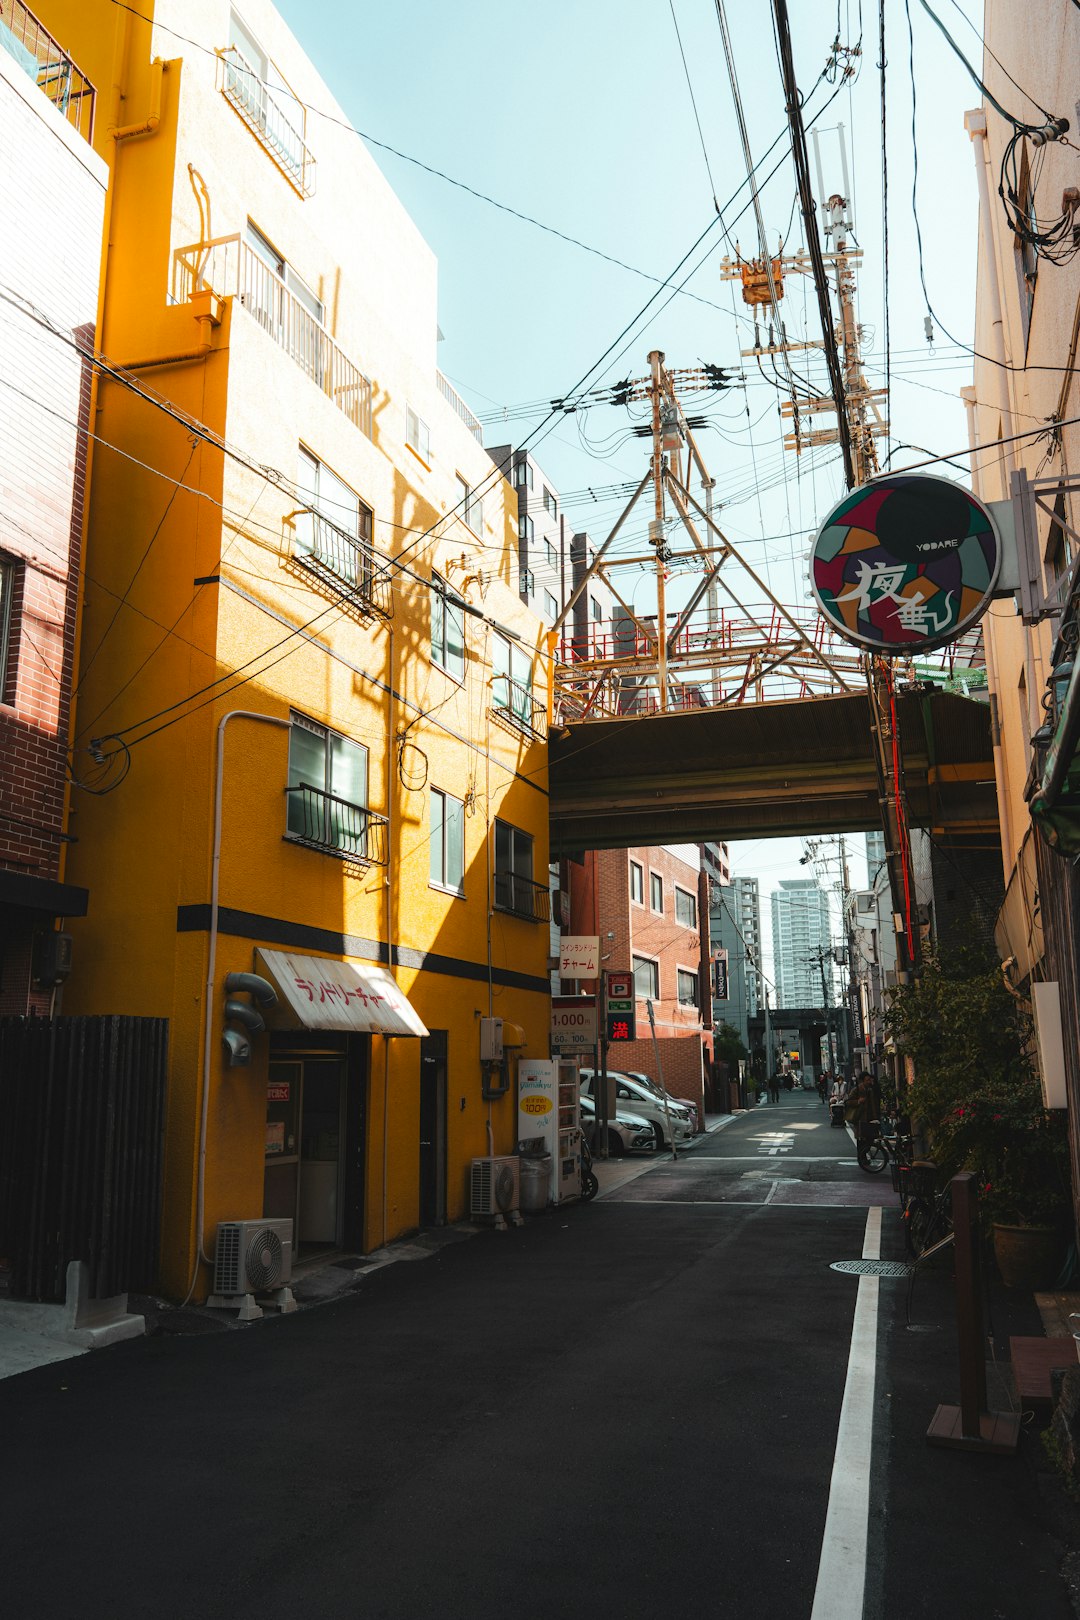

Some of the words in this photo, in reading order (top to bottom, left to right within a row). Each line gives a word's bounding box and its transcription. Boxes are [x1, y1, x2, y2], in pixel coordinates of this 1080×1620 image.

[916, 538, 959, 552] YODARE
[561, 943, 598, 952] コインランドリー
[562, 958, 595, 971] チャーム
[615, 985, 625, 994] P
[612, 1021, 629, 1039] 満
